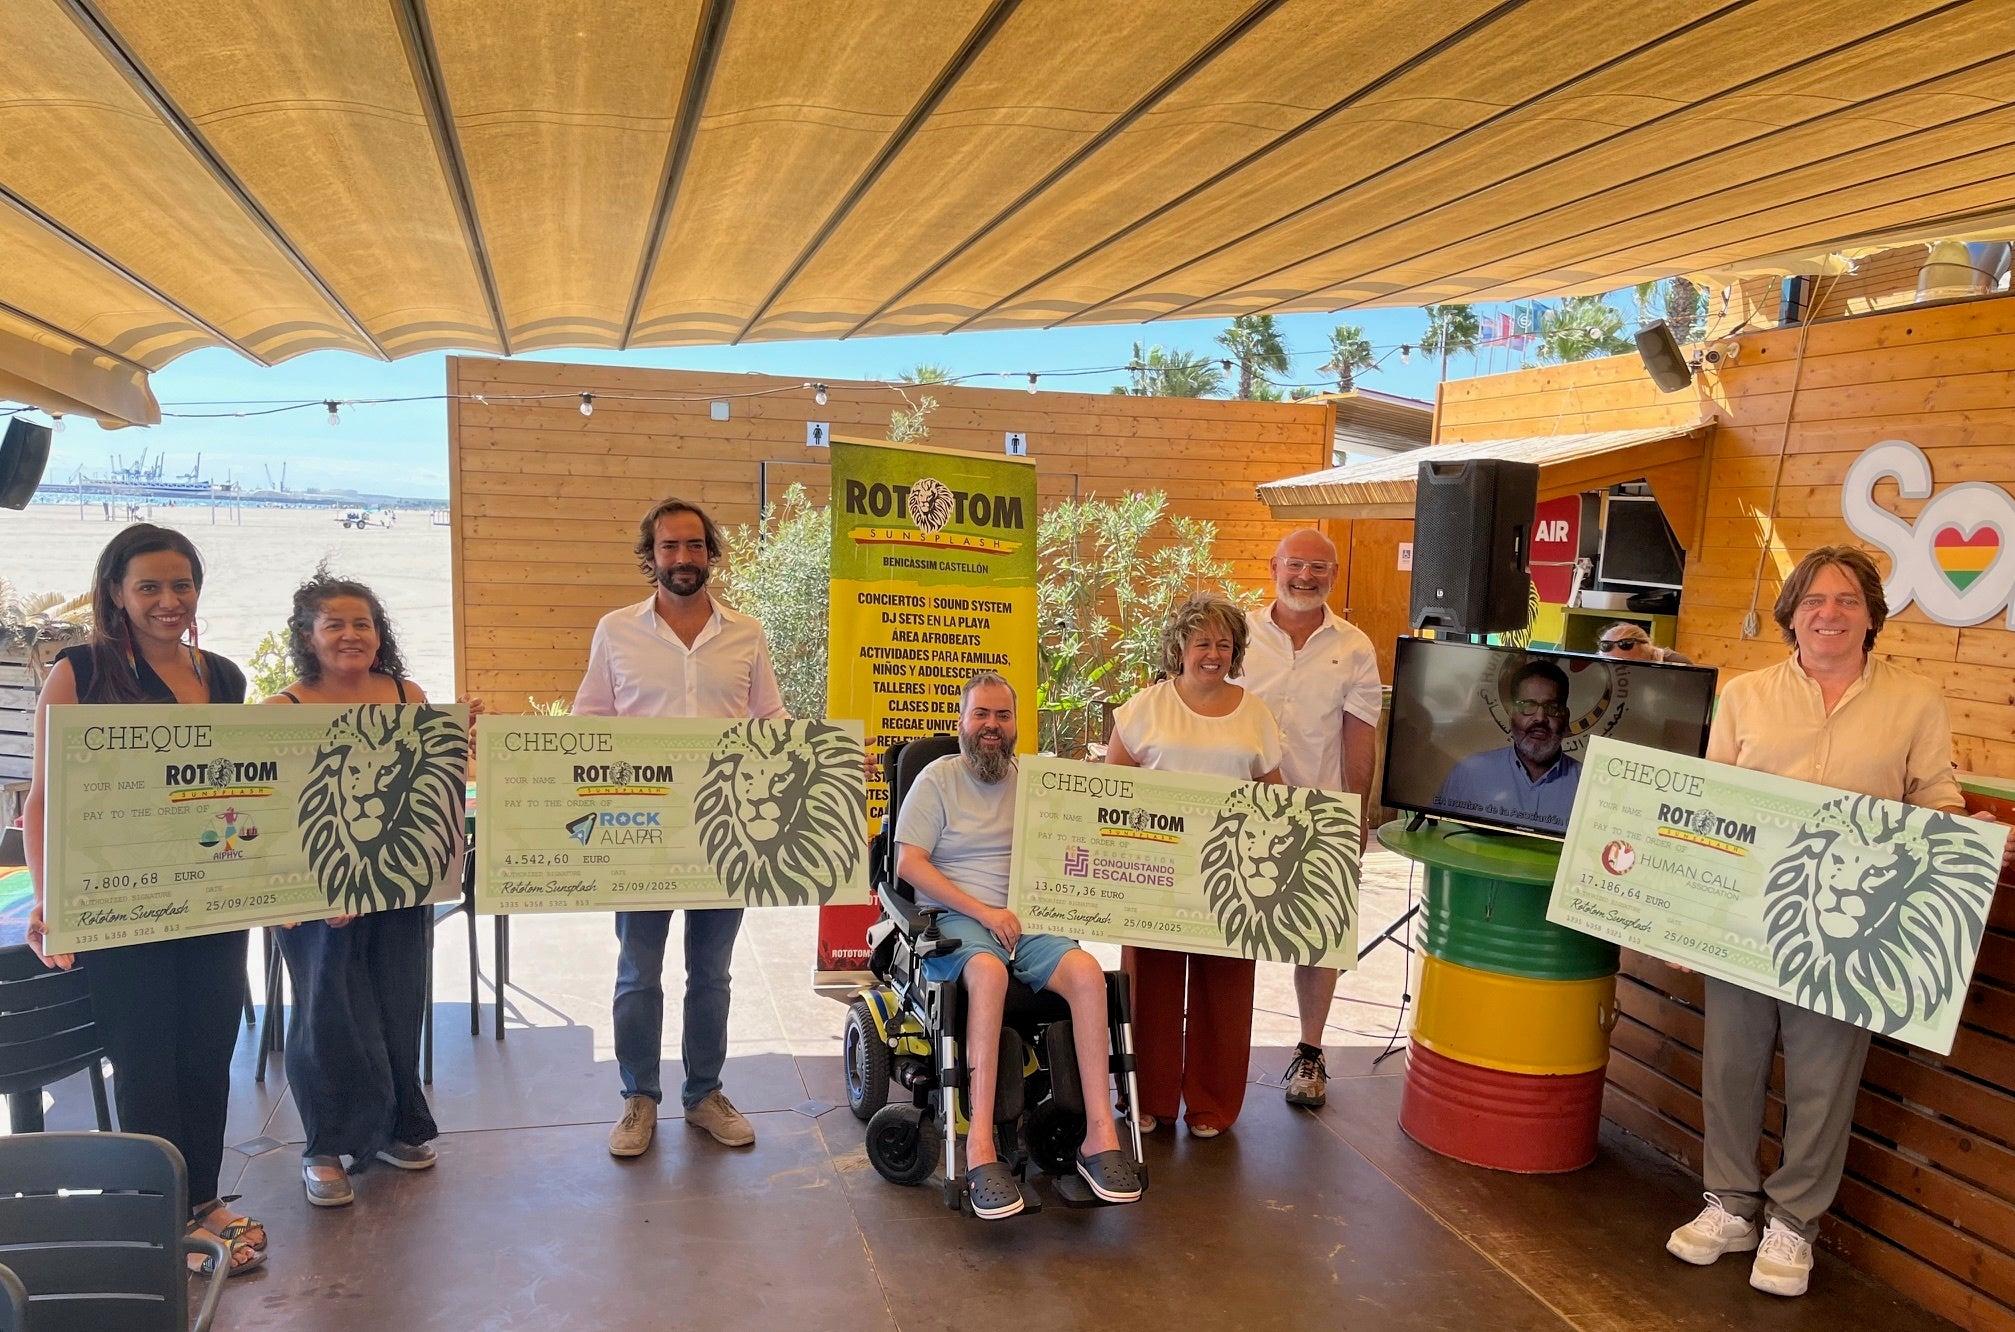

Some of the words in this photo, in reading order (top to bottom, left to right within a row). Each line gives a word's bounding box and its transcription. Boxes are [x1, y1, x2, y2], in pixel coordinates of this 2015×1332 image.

[870, 528, 1001, 548] SUNSPLASH
[1535, 520, 1569, 543] AIR
[883, 555, 937, 571] BENICÀSSIM
[939, 560, 989, 574] CASTELLÓN
[857, 592, 926, 608] CONCIERTOS
[933, 597, 969, 611] SOUND
[971, 600, 1012, 614] SYSTEM
[881, 611, 897, 624] DJ
[898, 613, 925, 626] SETS
[927, 615, 941, 627] EN
[943, 616, 957, 628] LA
[958, 616, 990, 630] PLAYA
[891, 627, 920, 643] ÁREA
[921, 631, 981, 647] AFROBEATS
[859, 646, 930, 661] ACTIVIDADES
[931, 651, 959, 663] PARA
[961, 652, 1011, 667] FAMILIAS,
[872, 661, 907, 677] NIÑOS
[909, 664, 917, 677] Y
[873, 681, 926, 695] TALLERES
[933, 683, 961, 696] YOGA
[888, 699, 929, 713] CLASES
[931, 701, 946, 713] DE
[947, 702, 961, 714] BA
[881, 717, 924, 731] REGGAE
[926, 718, 959, 731] UNIVE
[84, 725, 212, 753] CHEQUE
[504, 732, 613, 755] CHEQUE
[83, 783, 110, 792] YOUR
[118, 781, 145, 790] NAME
[1041, 771, 1134, 799] CHEQUE
[1607, 757, 1705, 797] CHEQUE
[181, 788, 264, 798] SUNSPLASH
[83, 811, 104, 821] PAY
[110, 810, 125, 819] TO
[131, 808, 151, 818] THE
[157, 806, 190, 816] ORDER
[196, 804, 210, 814] OF
[1040, 811, 1059, 820] YOUR
[1063, 814, 1082, 822] NAME
[1599, 799, 1618, 811] YOUR
[1622, 806, 1643, 817] NAME
[600, 812, 660, 826] ROCK
[1038, 832, 1054, 840] PAY
[1072, 836, 1087, 844] THE
[1090, 837, 1115, 847] ORDER
[1593, 821, 1609, 832] PAY
[1612, 827, 1623, 836] TO
[1626, 830, 1642, 841] THE
[1645, 836, 1673, 849] ORDER
[1675, 844, 1688, 853] OF
[1666, 830, 1739, 852] SUNSPLASH
[505, 854, 569, 866] 4.542,60
[583, 855, 610, 864] EURO
[1093, 858, 1175, 875] CONQUISTANDO
[82, 872, 158, 892] 7.800,68
[174, 870, 205, 882] EURO
[1093, 869, 1174, 887] ESCALONES
[1640, 853, 1698, 880] HUMAN
[1701, 870, 1741, 893] CALL
[501, 881, 544, 894] Rototom
[545, 880, 597, 896] Sunsplash
[611, 881, 677, 892] 25/09/2025
[1035, 881, 1096, 897] 13.057,36
[1101, 890, 1125, 900] EURO
[1580, 873, 1641, 900] 17.186,64
[1645, 894, 1671, 909] EURO
[1686, 880, 1740, 901] ASSOCIATION
[206, 894, 276, 911] 25/09/2025
[77, 908, 128, 927] Rototom
[129, 899, 190, 923] Sunsplash
[1029, 905, 1065, 918] Rototom
[1067, 909, 1112, 926] Sunsplash
[1570, 898, 1606, 919] Rototom
[1605, 909, 1653, 933] Sunsplash
[1124, 918, 1182, 932] 25/09/2025
[75, 933, 99, 944] 1335
[133, 926, 155, 937] 5321
[1663, 930, 1728, 958] 25/09/2025
[832, 949, 873, 958] ROTOTOMS
